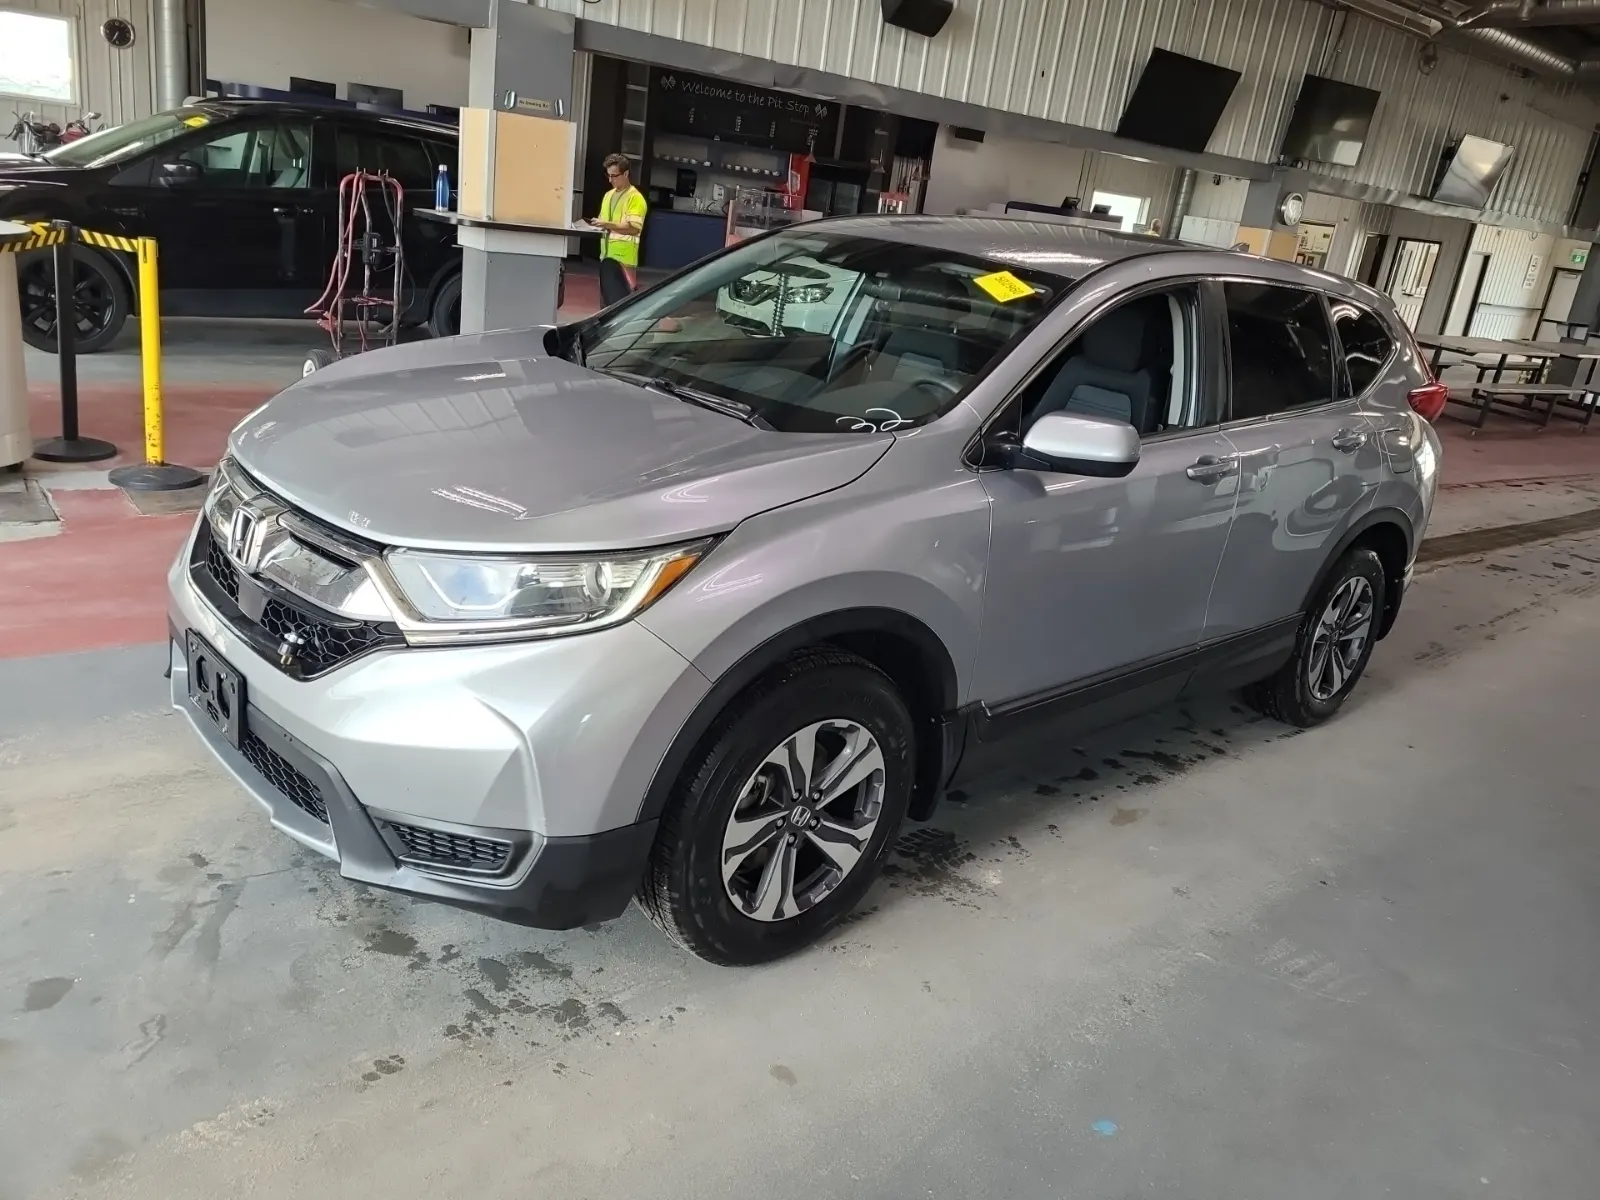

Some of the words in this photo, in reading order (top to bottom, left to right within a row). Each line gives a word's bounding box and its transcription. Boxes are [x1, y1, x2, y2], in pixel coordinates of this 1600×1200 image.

[682, 80, 732, 100] Welcome
[735, 92, 745, 103] to
[748, 91, 765, 106] the
[768, 97, 783, 108] Pit
[786, 100, 810, 118] Stop
